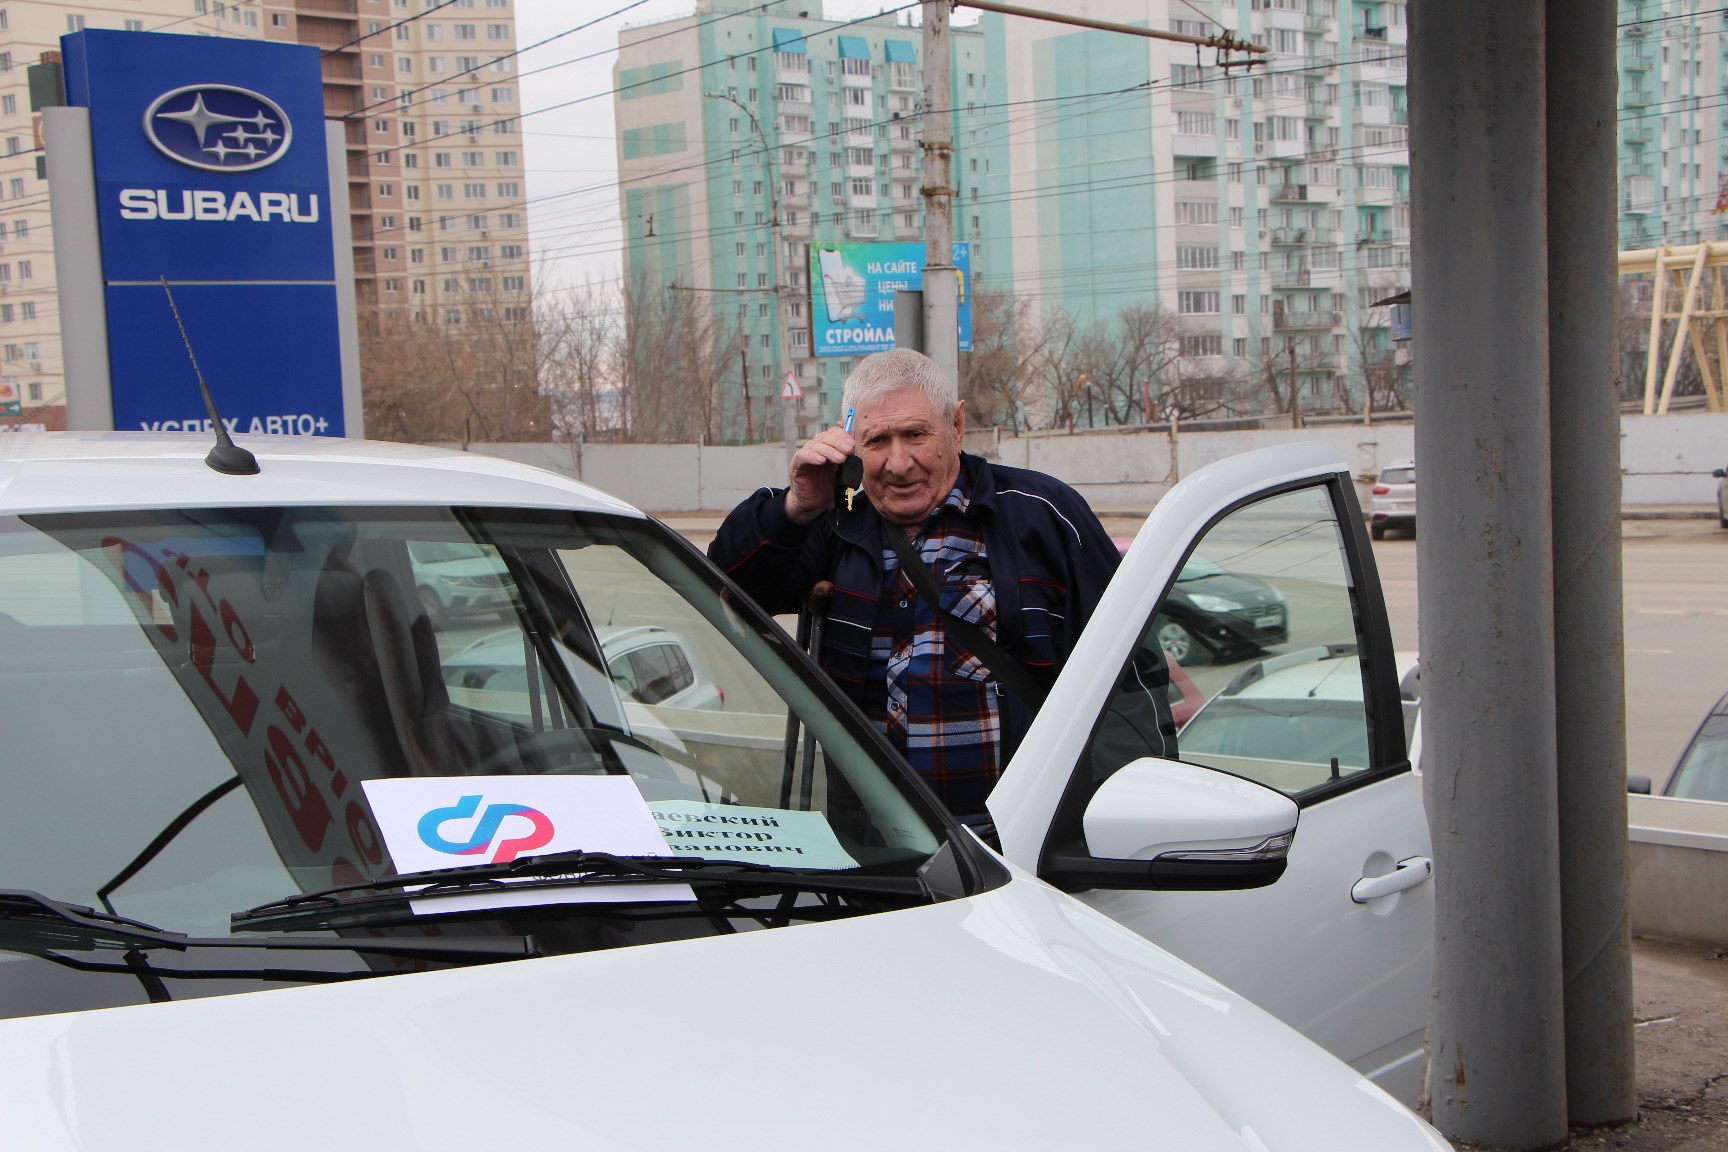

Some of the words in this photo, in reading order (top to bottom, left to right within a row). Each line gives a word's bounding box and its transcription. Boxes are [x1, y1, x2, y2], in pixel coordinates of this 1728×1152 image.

[119, 189, 319, 223] SUBARU
[867, 261, 883, 274] НА
[884, 259, 918, 274] САЙТЕ
[878, 280, 908, 295] ЦЕНЫ
[250, 413, 328, 437] АВТО+
